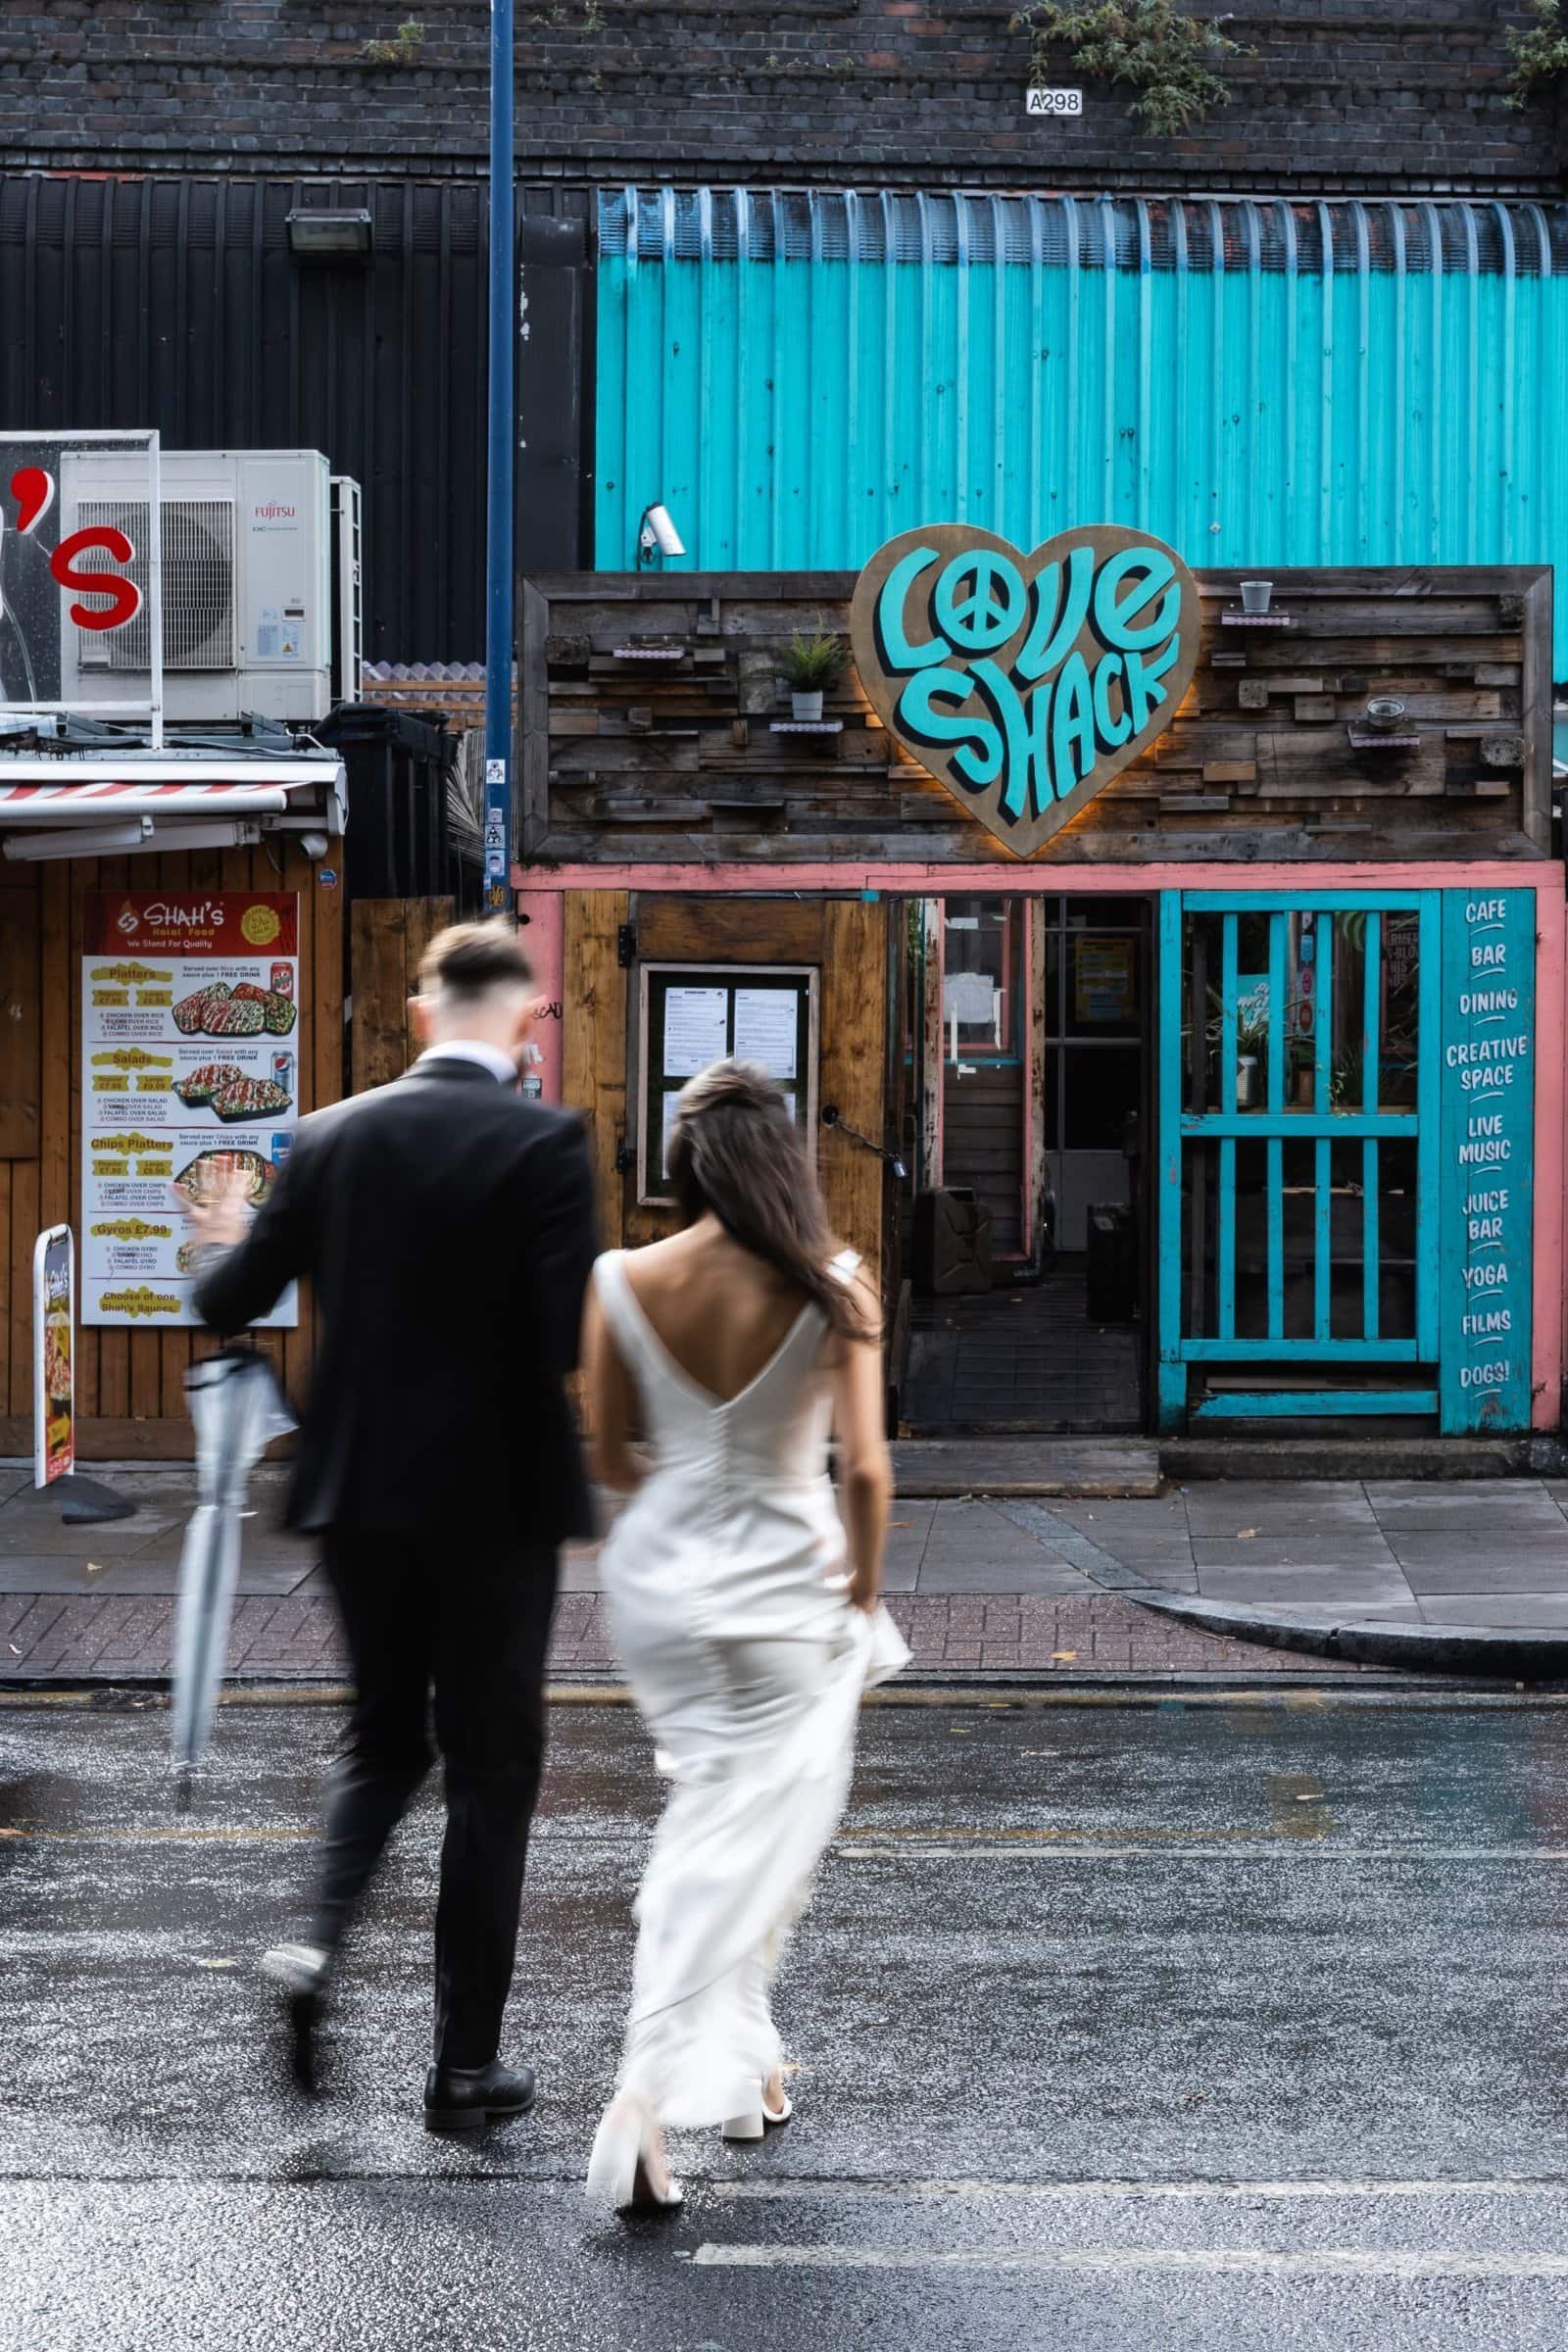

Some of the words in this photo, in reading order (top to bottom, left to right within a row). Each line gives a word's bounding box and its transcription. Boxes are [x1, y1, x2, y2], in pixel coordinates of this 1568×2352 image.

[1030, 93, 1079, 111] A298
[255, 506, 295, 519] FUJITSU
[893, 632, 1180, 827] SHACK
[1466, 900, 1506, 923] CAFE
[127, 940, 140, 949] We
[143, 940, 166, 949] Stand
[169, 940, 181, 949] For
[183, 940, 213, 950] Quality
[1472, 944, 1505, 965] BAR
[109, 968, 157, 979] Platters
[1460, 989, 1517, 1014] DINING
[113, 1053, 152, 1064] Salads
[1446, 1036, 1527, 1067] CREATIVE
[1461, 1064, 1513, 1091] SPACE
[1469, 1115, 1502, 1138] LIVE
[91, 1138, 124, 1151] Chips
[128, 1138, 173, 1150] Platters
[1458, 1140, 1510, 1164] MUSIC
[1462, 1190, 1508, 1216] JUICE
[97, 1225, 132, 1236] Gyros
[135, 1225, 167, 1235] £7.99
[1469, 1217, 1502, 1240] BAR
[1462, 1263, 1508, 1289] YOGA
[103, 1292, 140, 1300] Choose
[143, 1292, 154, 1300] of
[1462, 1310, 1510, 1335] FILMS
[1460, 1360, 1509, 1388] DOGS!
